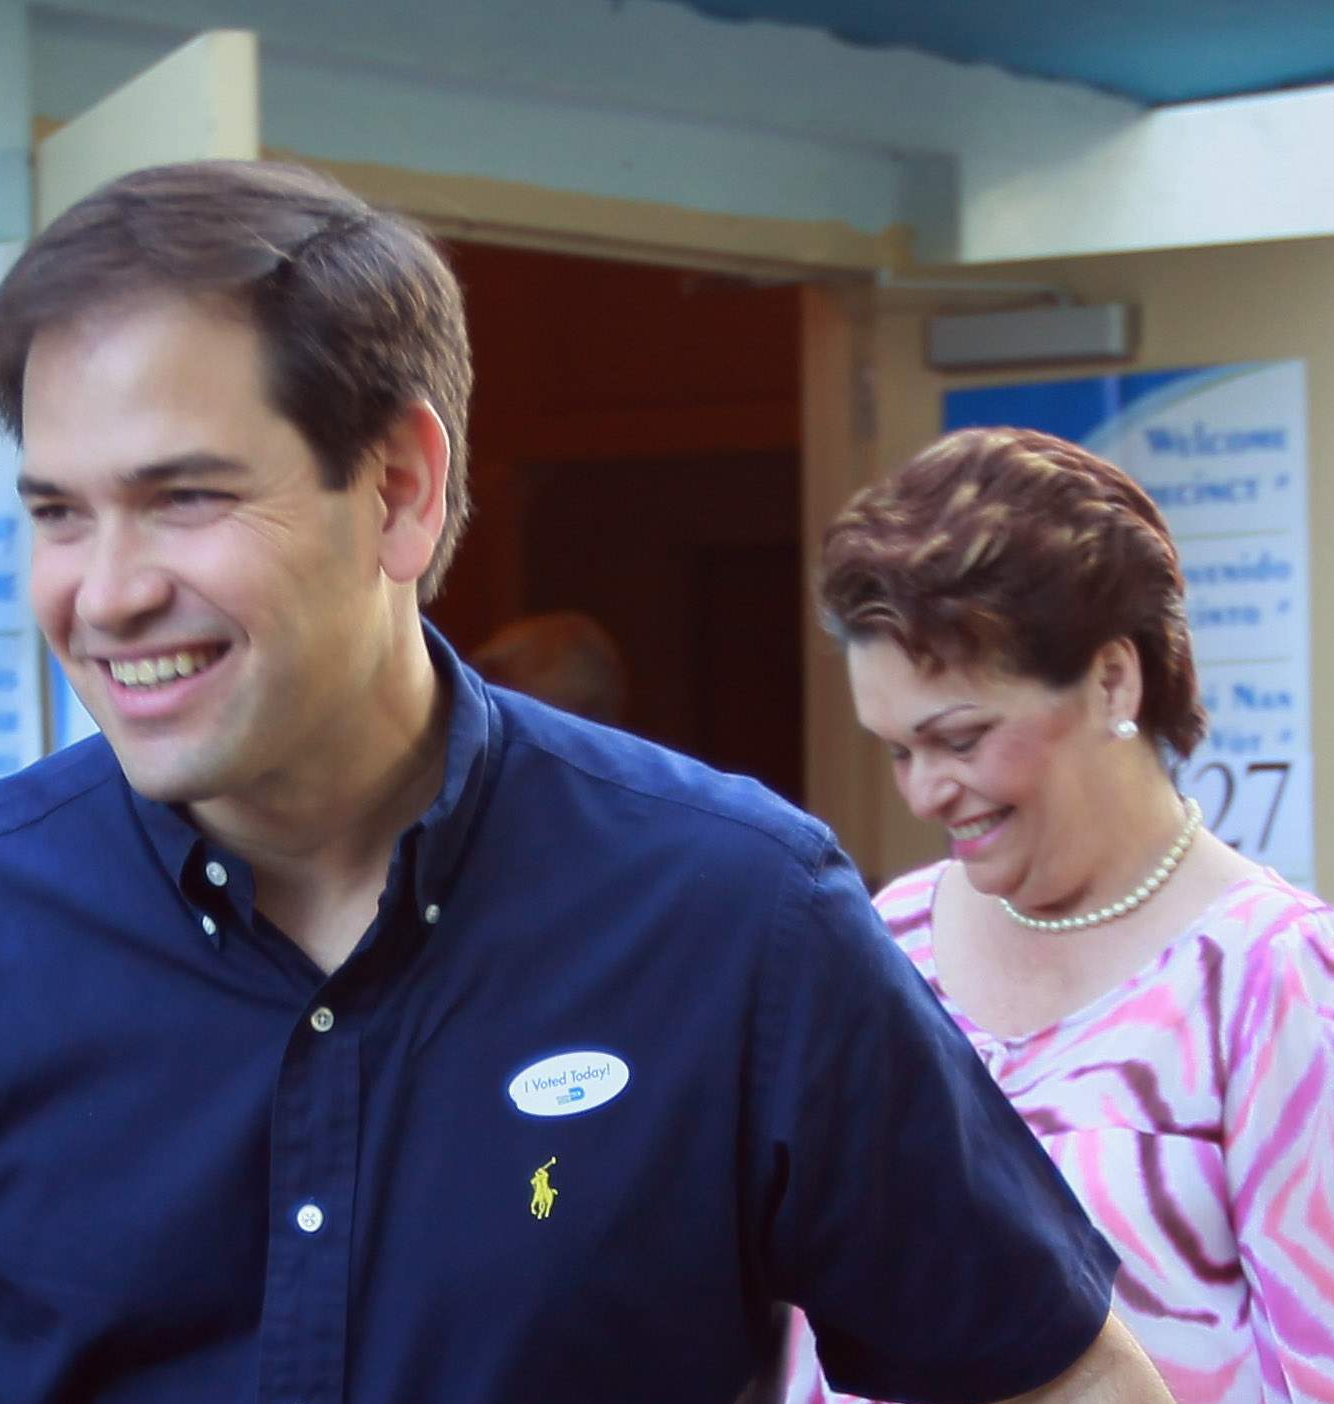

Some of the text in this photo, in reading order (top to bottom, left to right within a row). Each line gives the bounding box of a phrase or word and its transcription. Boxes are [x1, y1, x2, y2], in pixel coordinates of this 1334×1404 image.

[524, 1062, 611, 1093] I Voted Today!
